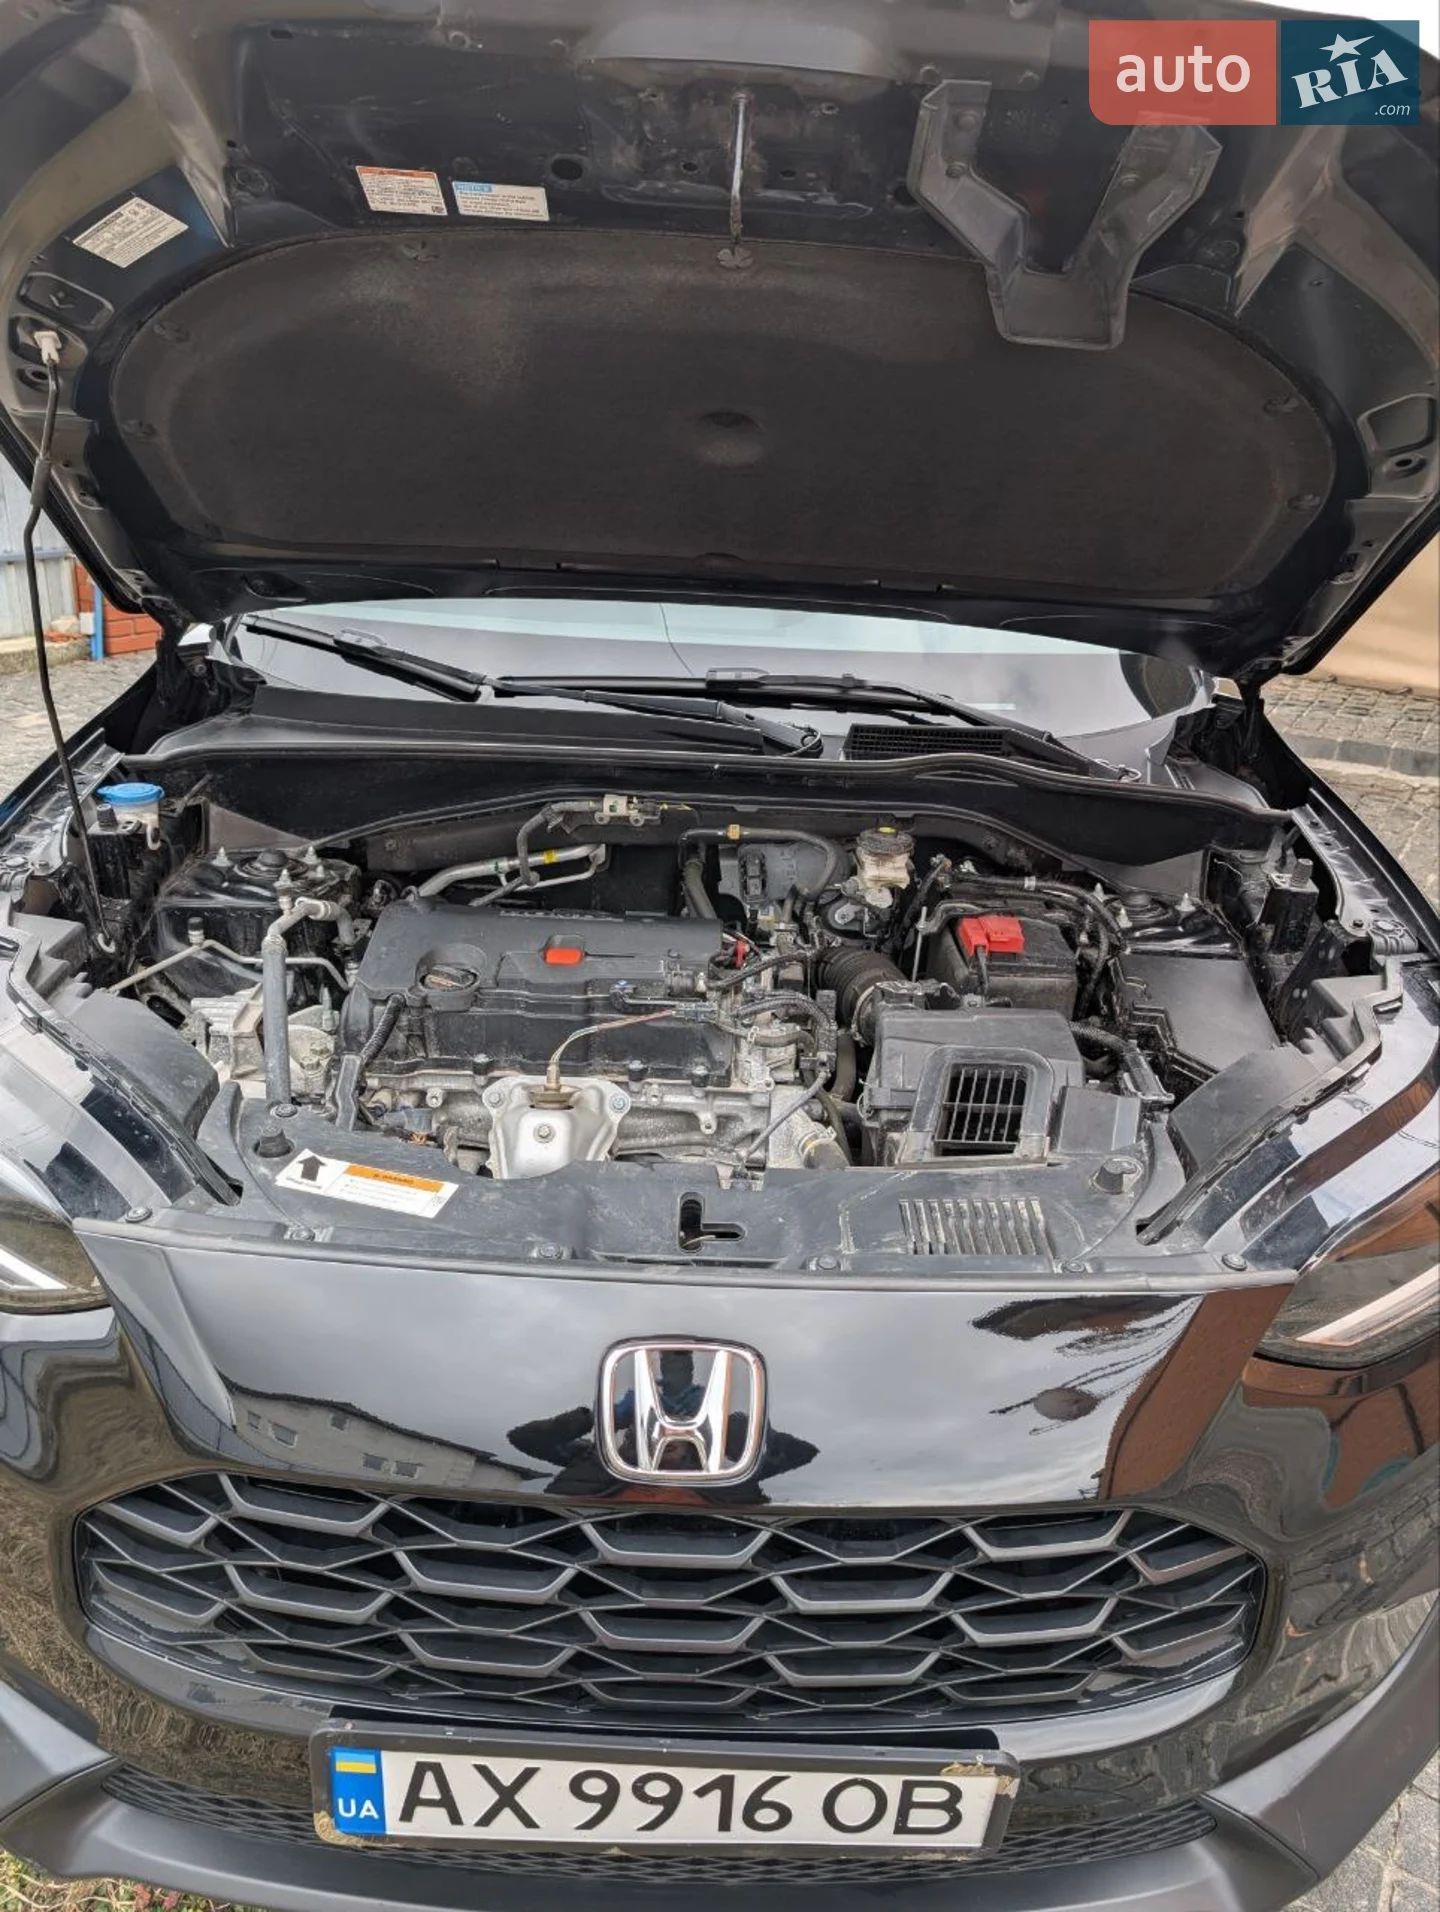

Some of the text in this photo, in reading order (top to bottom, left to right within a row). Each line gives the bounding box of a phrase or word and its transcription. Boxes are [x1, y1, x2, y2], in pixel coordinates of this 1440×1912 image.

[338, 1798, 379, 1820] UA
[398, 1760, 963, 1835] AX 9916 OB
